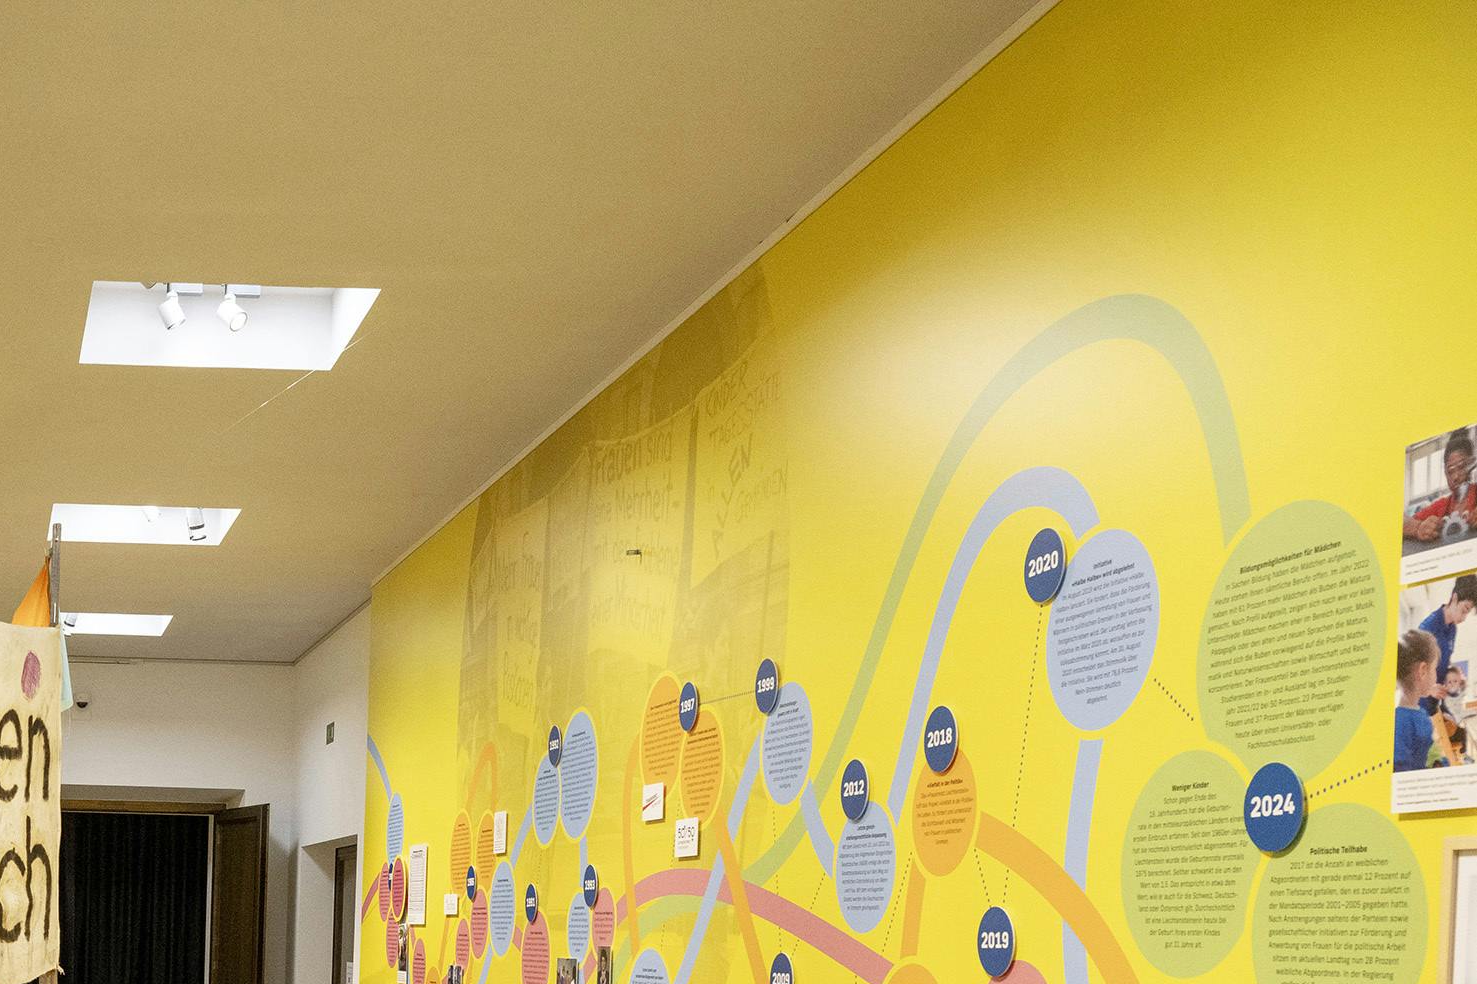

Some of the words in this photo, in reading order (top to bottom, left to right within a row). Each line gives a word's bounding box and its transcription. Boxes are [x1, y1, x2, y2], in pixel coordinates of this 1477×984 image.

[1028, 550, 1058, 577] 2020
[1240, 552, 1303, 574] Bildungsmöglichkeiten
[1314, 541, 1341, 553] Mädchen
[757, 676, 775, 693] 1999
[681, 698, 695, 713] 1997
[927, 727, 952, 748] 2018
[843, 779, 865, 797] 2012
[1192, 782, 1209, 790] Kinder
[1250, 793, 1295, 818] 2024
[981, 932, 1009, 949] 2019
